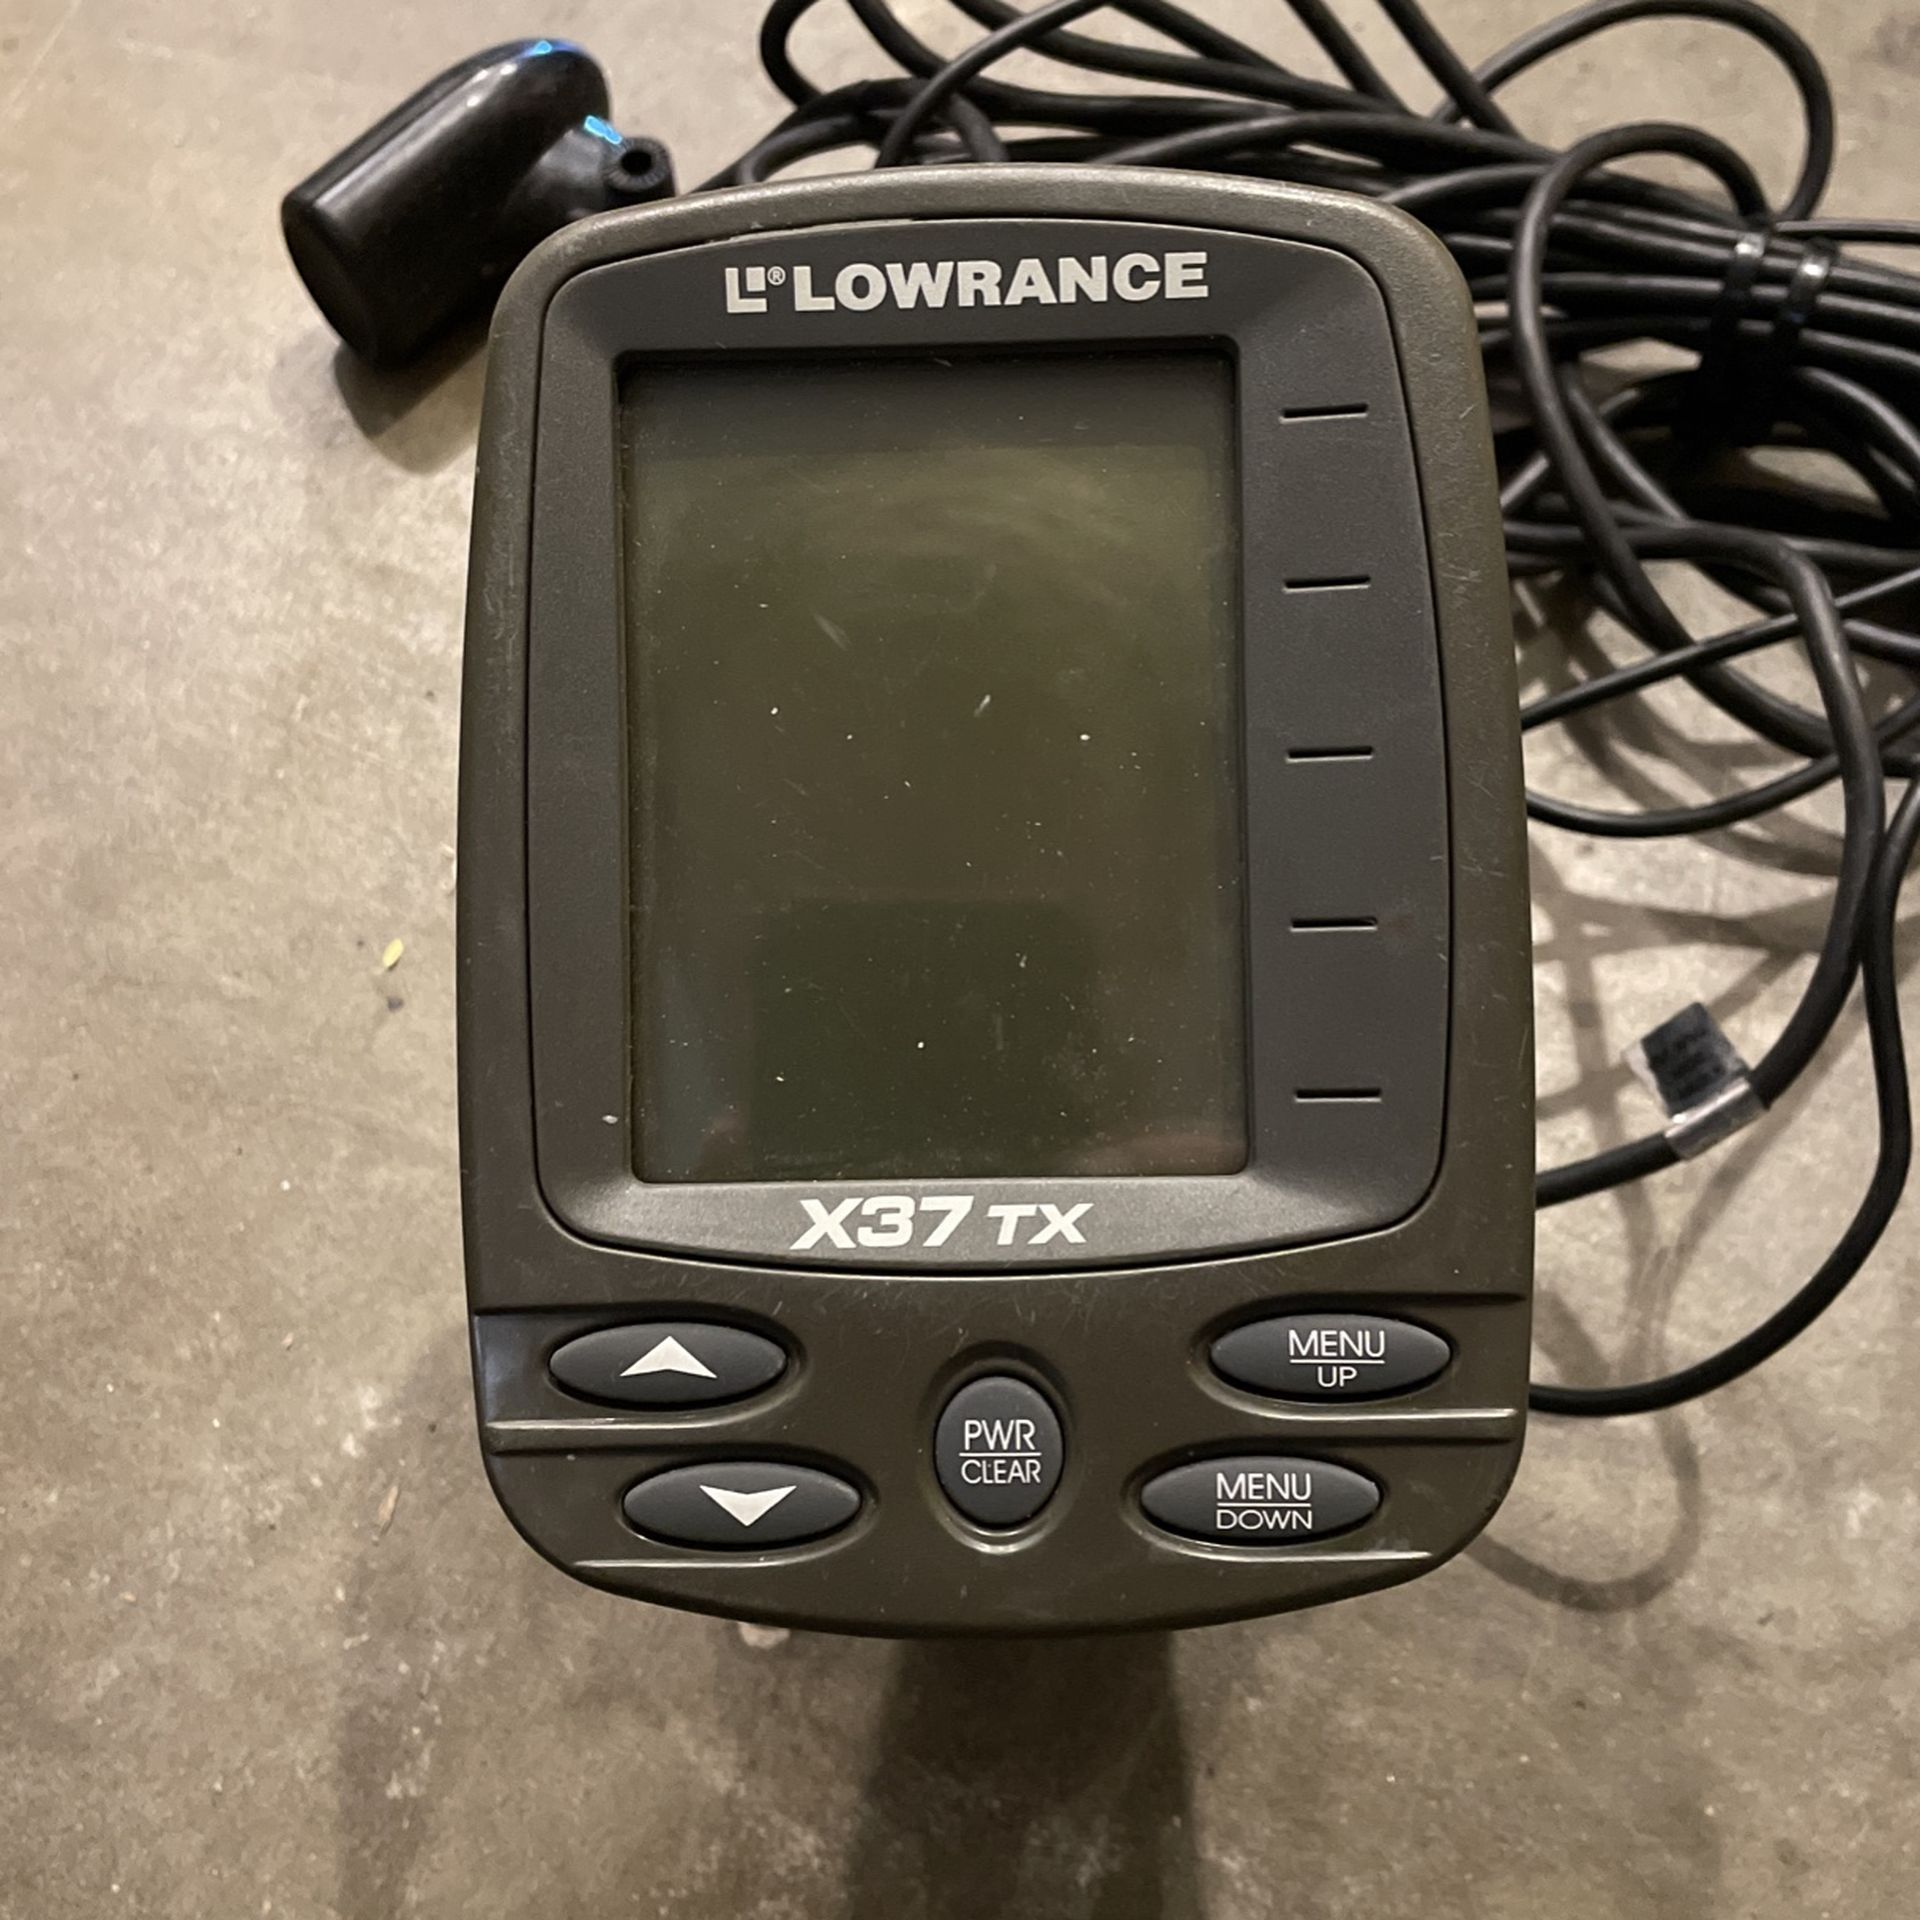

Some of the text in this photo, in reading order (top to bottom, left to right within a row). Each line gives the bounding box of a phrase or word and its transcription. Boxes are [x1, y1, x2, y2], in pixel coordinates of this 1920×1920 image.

[793, 251, 1209, 312] LOWRANCE
[789, 1195, 1095, 1250] X37 TX
[1288, 1329, 1386, 1358] MENU
[1316, 1365, 1358, 1388] UP
[963, 1418, 1036, 1451] PWR
[960, 1458, 1042, 1484] CLEAR
[1215, 1472, 1312, 1501] MENU
[1215, 1509, 1313, 1530] DOWN
